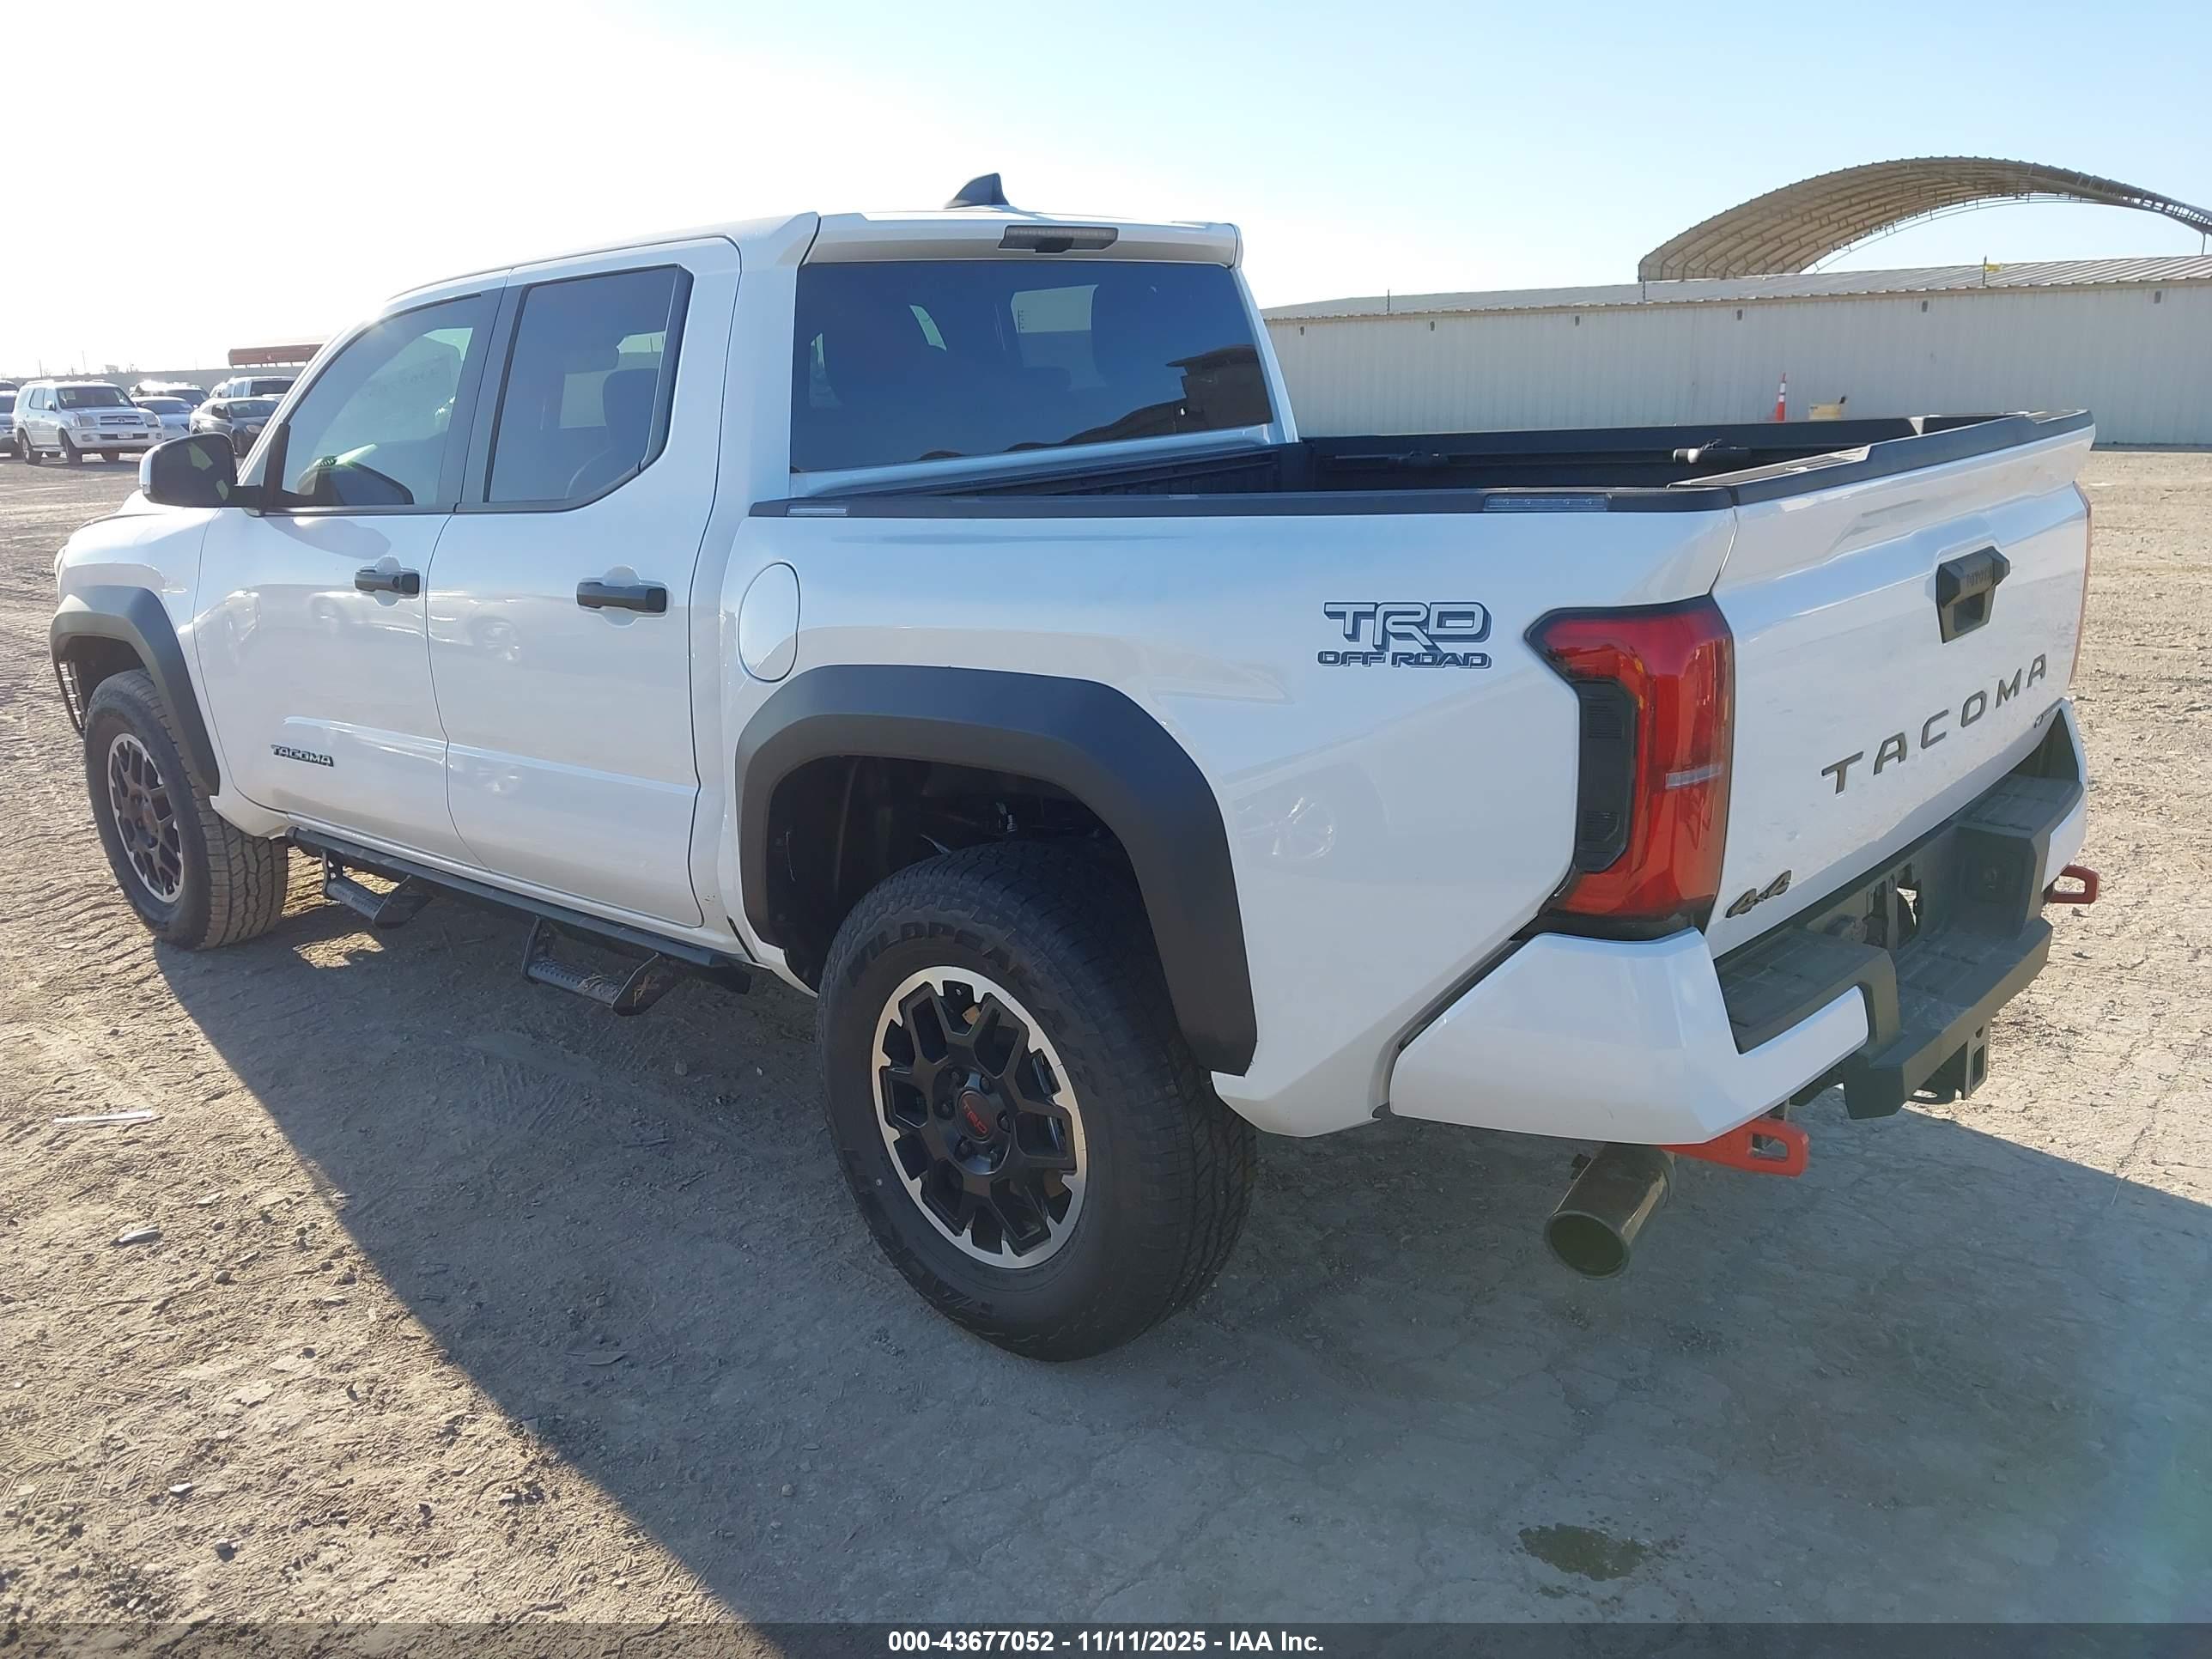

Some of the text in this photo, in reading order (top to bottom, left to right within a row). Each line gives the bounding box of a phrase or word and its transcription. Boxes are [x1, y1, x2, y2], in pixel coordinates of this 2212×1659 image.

[1323, 602, 1492, 653] TRD
[1317, 651, 1492, 668] OFF ROAD
[1821, 653, 2047, 795] TACOMA
[270, 744, 334, 767] TACOMA
[962, 1099, 988, 1134] TRD
